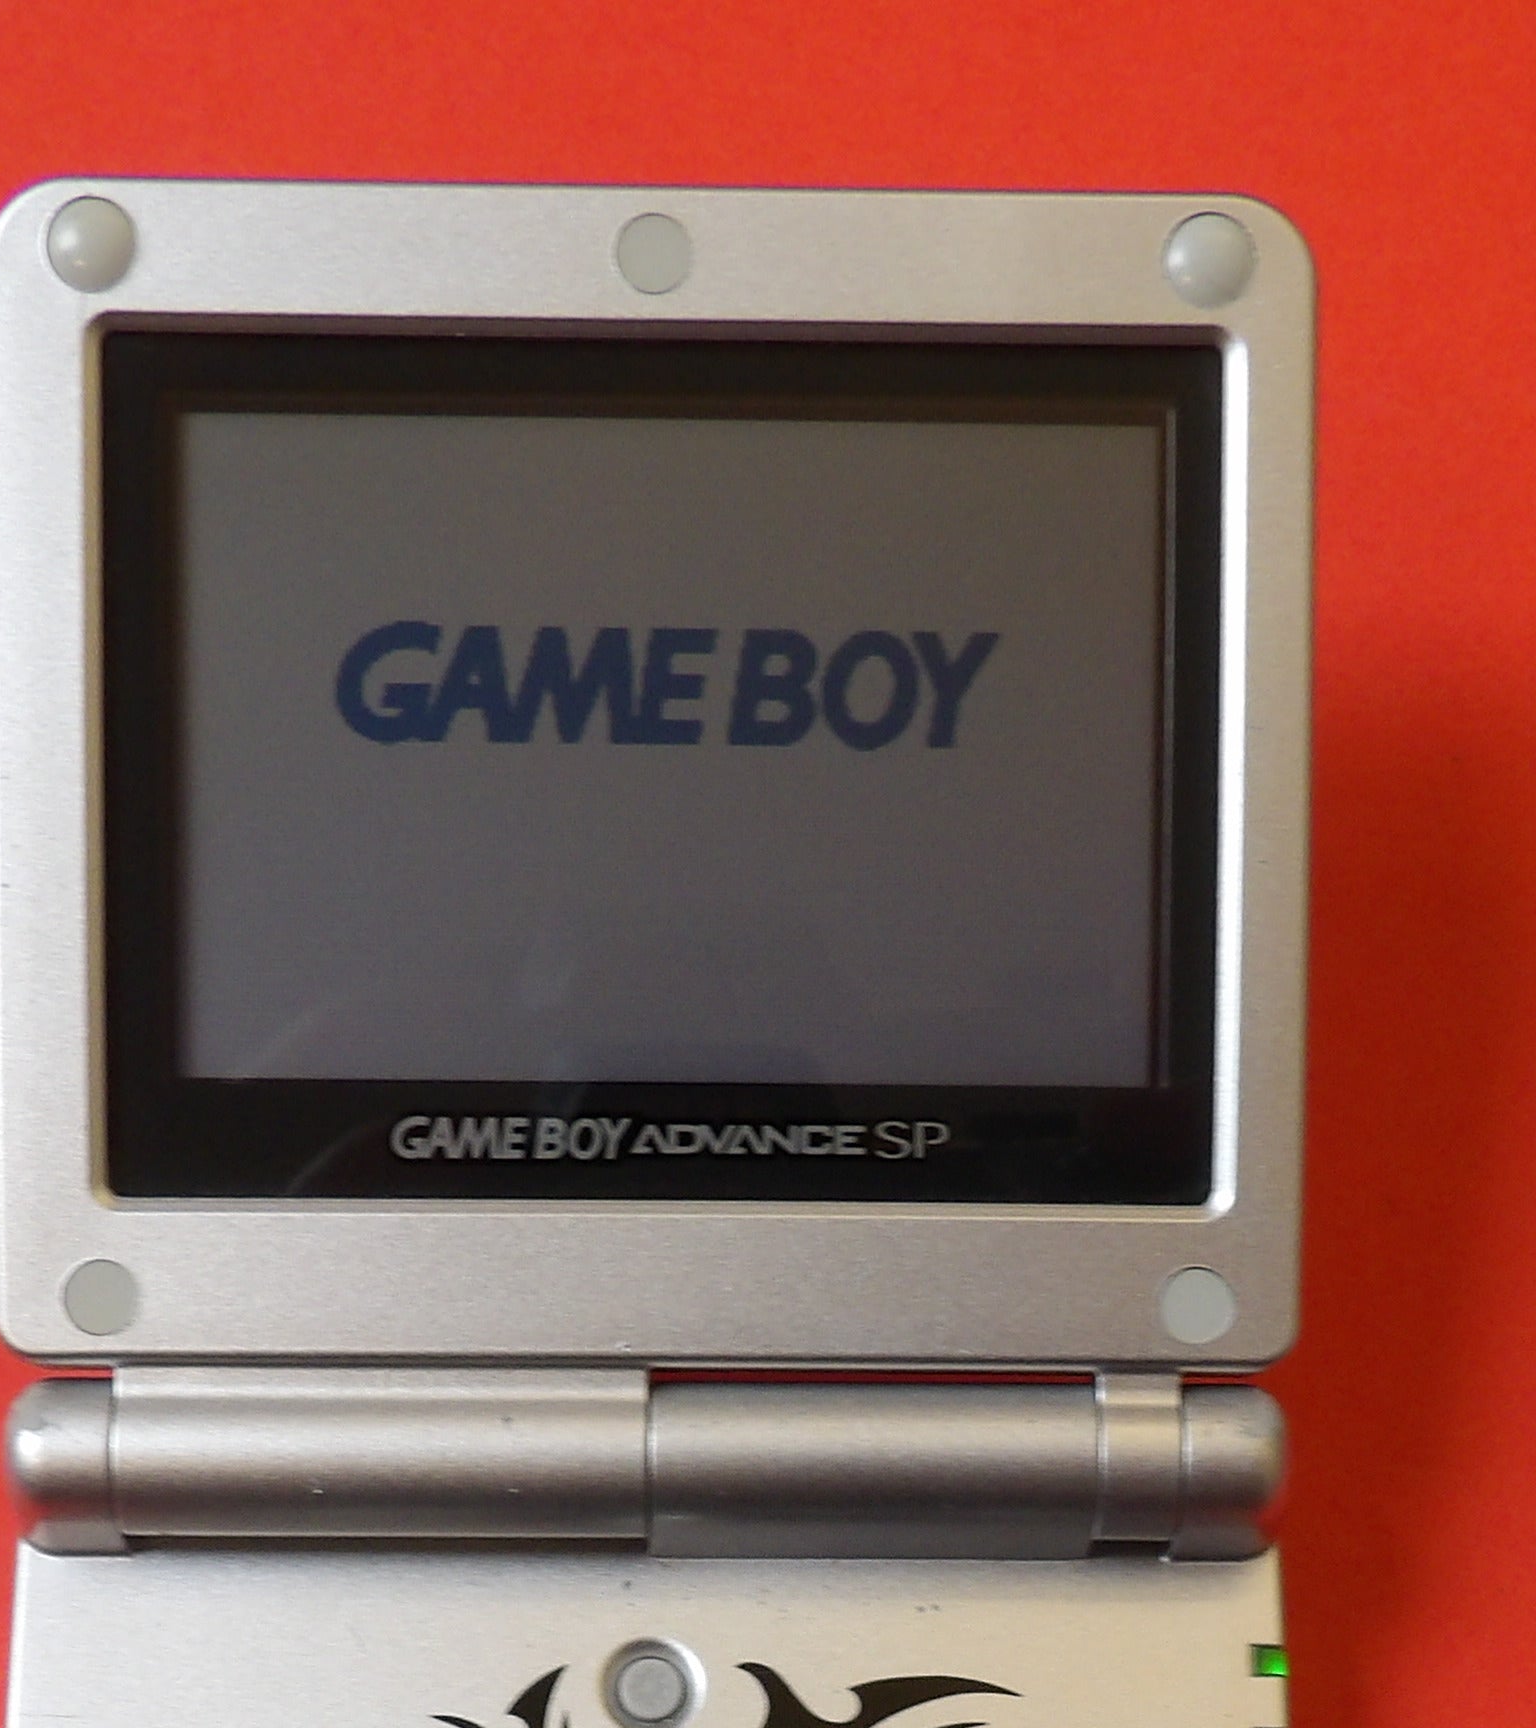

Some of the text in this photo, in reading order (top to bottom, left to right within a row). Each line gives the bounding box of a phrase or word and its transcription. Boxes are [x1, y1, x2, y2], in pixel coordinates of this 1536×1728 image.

[335, 620, 1002, 751] GAME BOY
[389, 1115, 952, 1160] GAME BOY ADVANCE SP
